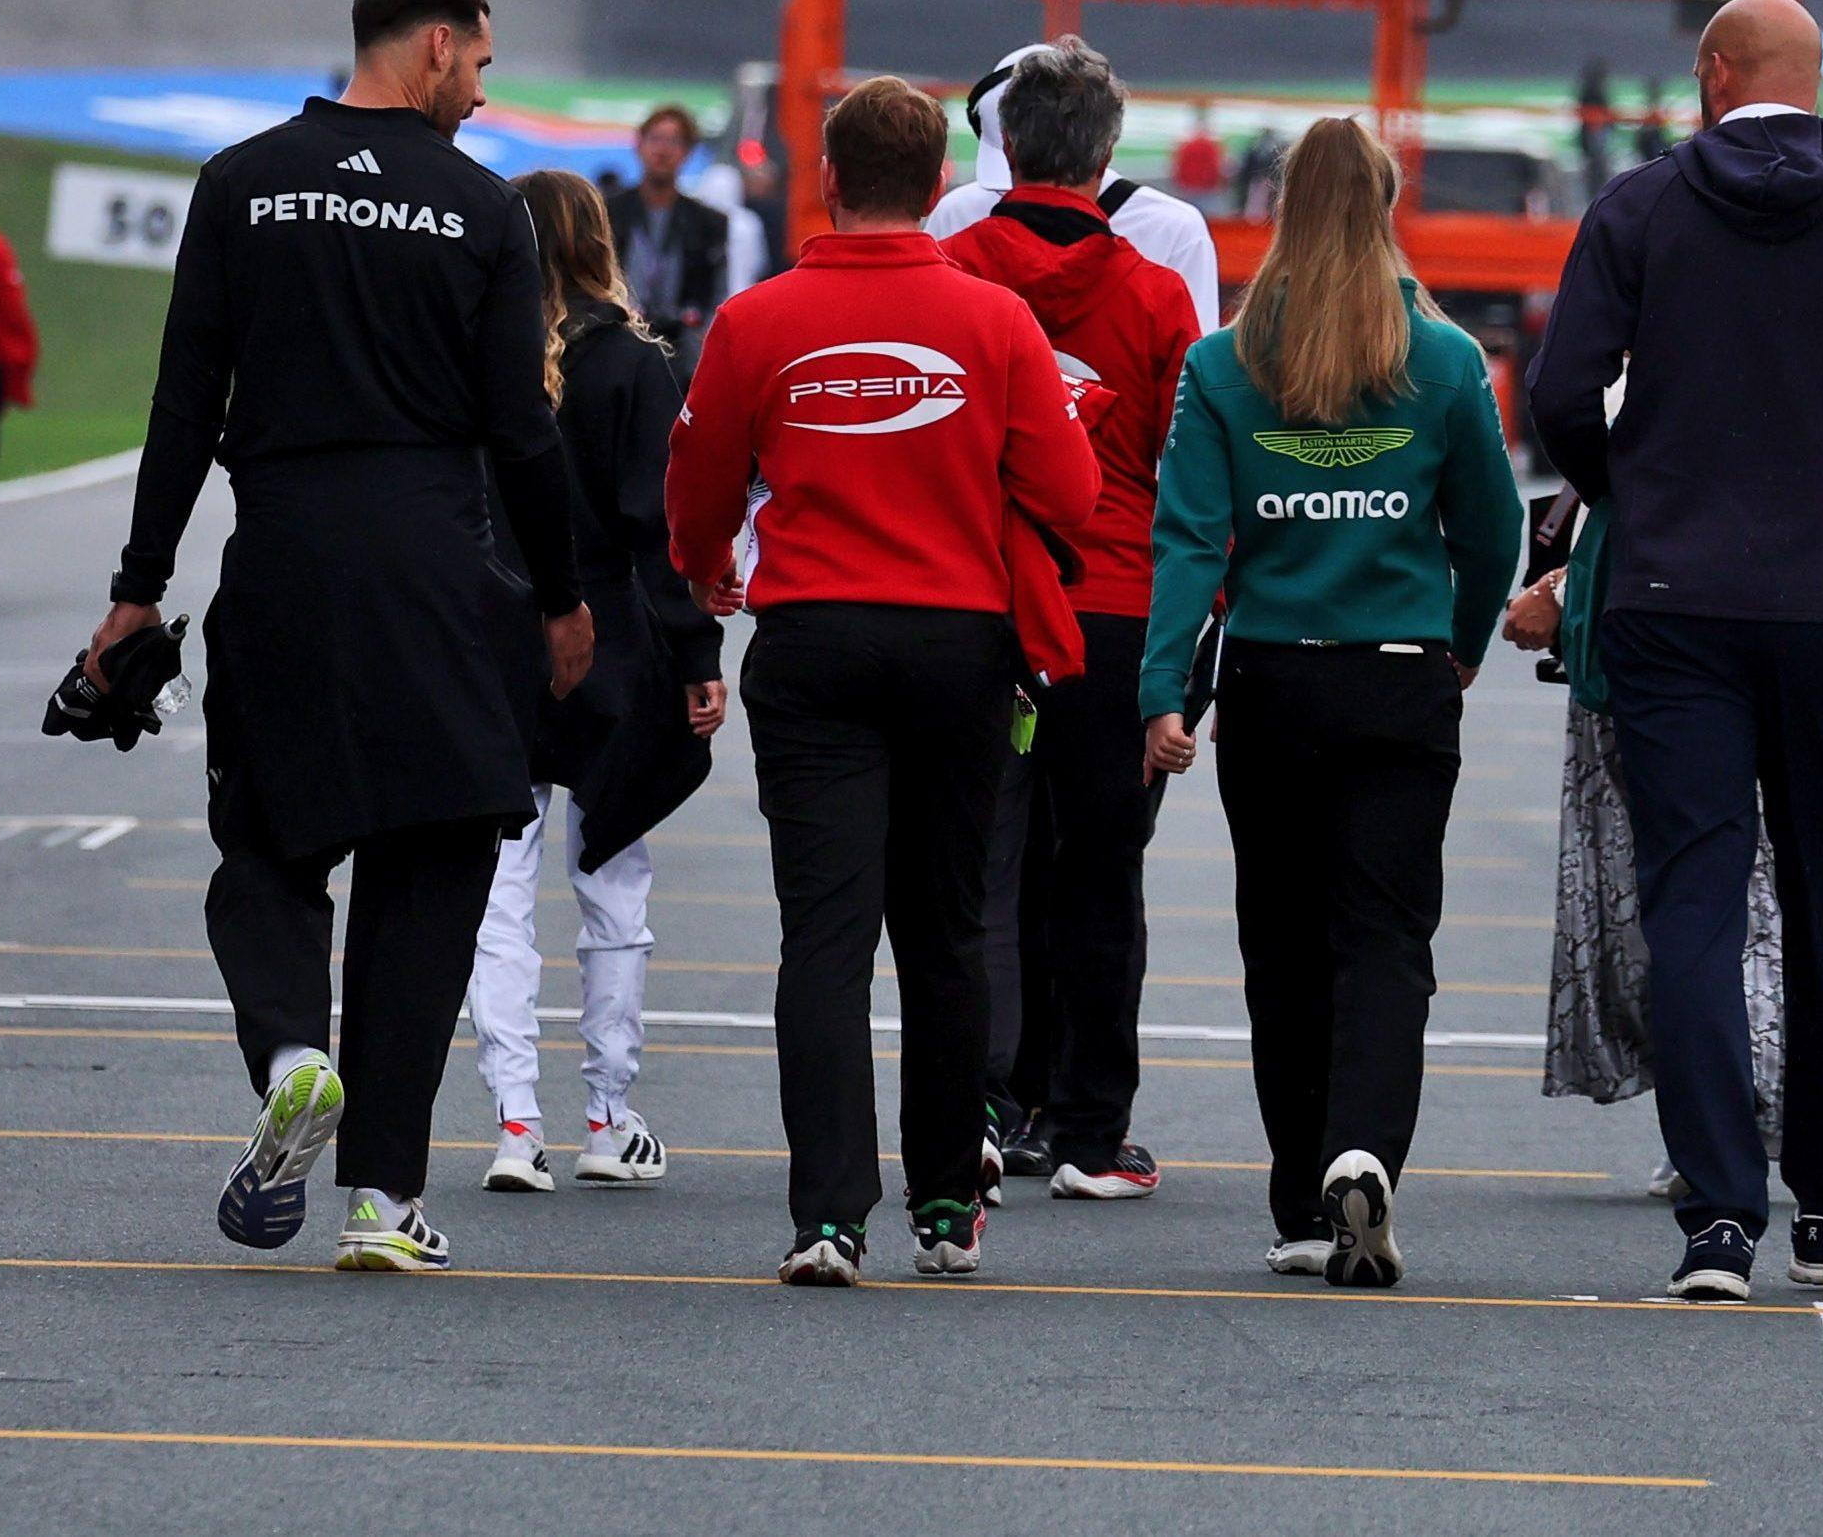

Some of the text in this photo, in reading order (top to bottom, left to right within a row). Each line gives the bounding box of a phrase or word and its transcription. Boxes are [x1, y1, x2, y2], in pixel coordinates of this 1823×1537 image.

[105, 195, 175, 247] 50
[249, 191, 465, 239] PETRONAS
[789, 376, 965, 404] PREMA
[1303, 436, 1372, 448] ASTON MARTIN
[1256, 489, 1410, 521] aramco
